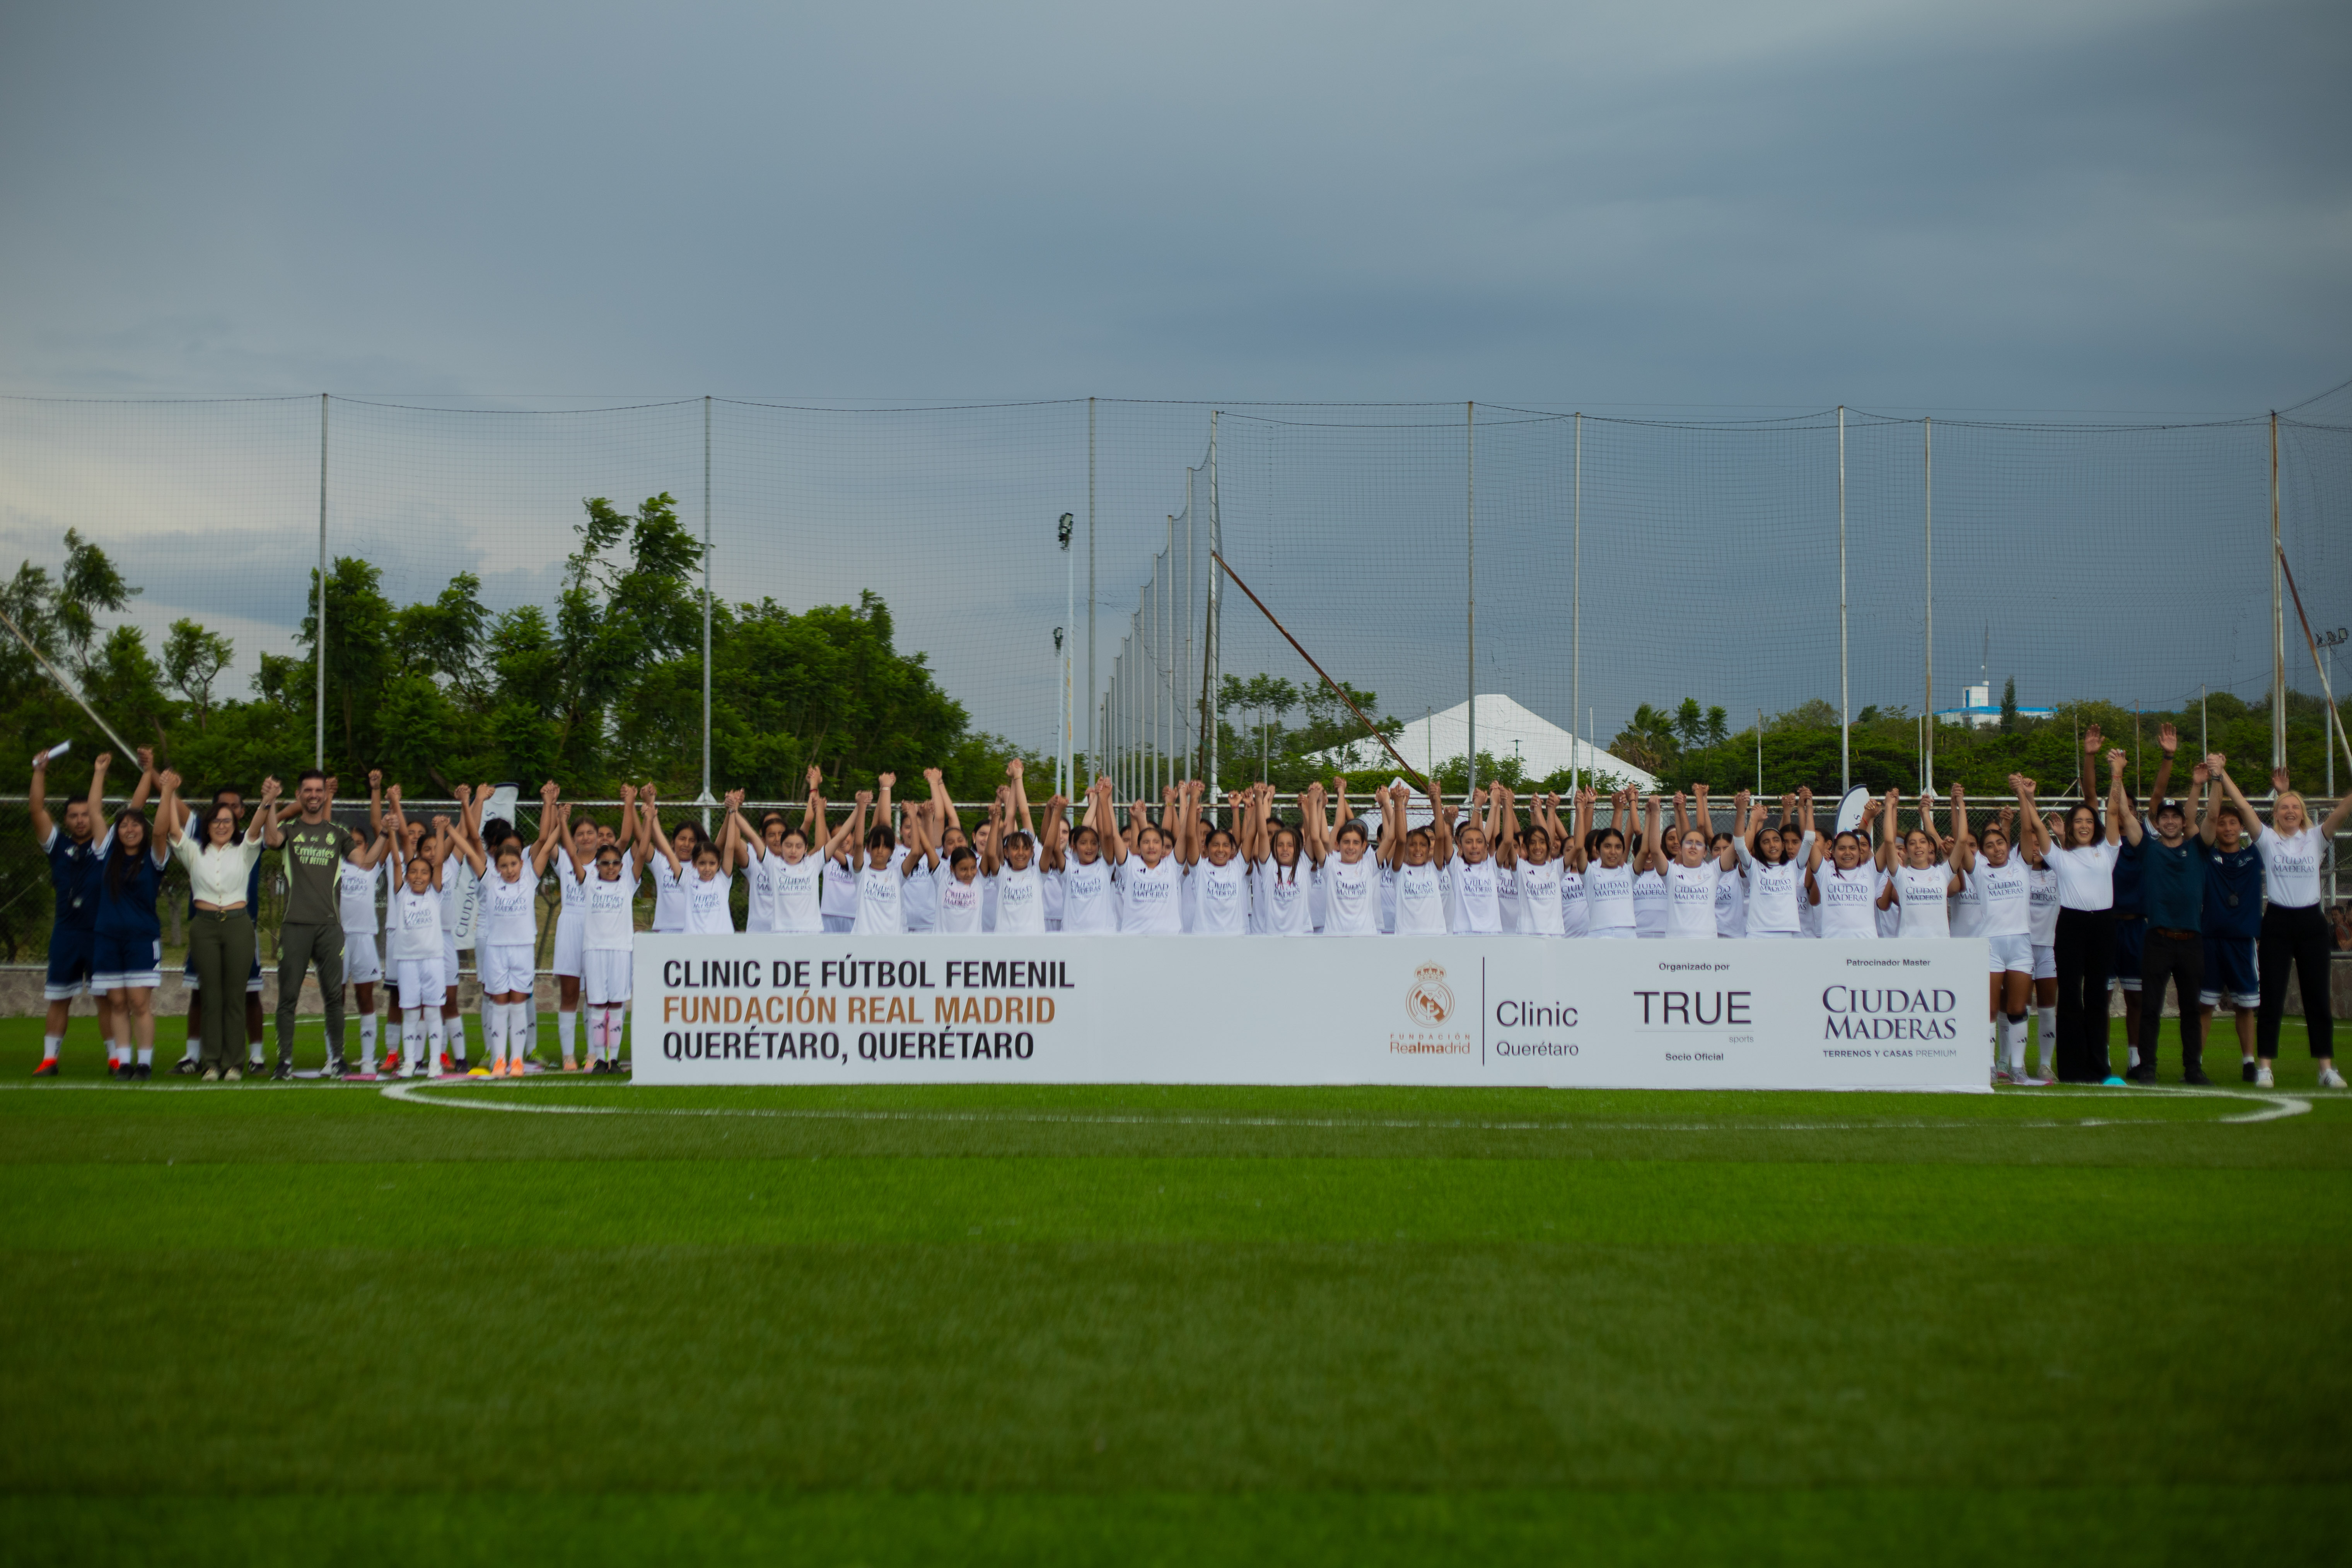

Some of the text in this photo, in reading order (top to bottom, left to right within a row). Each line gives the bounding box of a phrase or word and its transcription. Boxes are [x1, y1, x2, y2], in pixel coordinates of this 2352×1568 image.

[294, 845, 335, 858] Emirates
[2273, 855, 2314, 864] CIUDAD
[2274, 864, 2314, 873] MADERAS
[1133, 881, 1169, 892] CIUDAD
[1526, 881, 1556, 889] CIUDAD
[1593, 882, 1629, 891] CIUDAD
[1760, 878, 1791, 886] CIUDAD
[1988, 880, 2023, 890] CIUDAD
[1071, 886, 1101, 895] MADERAS
[1561, 884, 1584, 893] CIUD
[1595, 889, 1629, 897] MADERAS
[1674, 885, 1709, 893] CIUDAD
[1828, 884, 1867, 893] CIUDAD
[1989, 887, 2023, 897] MADERAS
[1133, 890, 1168, 899] MADERAS
[1562, 891, 1585, 901] MADE
[1828, 893, 1867, 901] MADERAS
[663, 952, 1075, 988] CLINIC DE FÚTBOL FEMENIL
[1659, 962, 1712, 972] Organizado
[1822, 985, 1956, 1013] CIUDAD
[664, 987, 1055, 1024] FUNDACIÓN REAL MADRID
[1633, 991, 1751, 1025] TRUE
[1496, 1000, 1578, 1027] Clinic
[1823, 1015, 1956, 1041] MADERAS
[663, 1024, 1034, 1065] QUERÉTARO, QUERÉTARO
[1729, 1035, 1754, 1044] sports
[1391, 1041, 1470, 1054] Realmadrid
[1496, 1041, 1579, 1056] Querétaro
[1666, 1053, 1724, 1061] Socio Oficial
